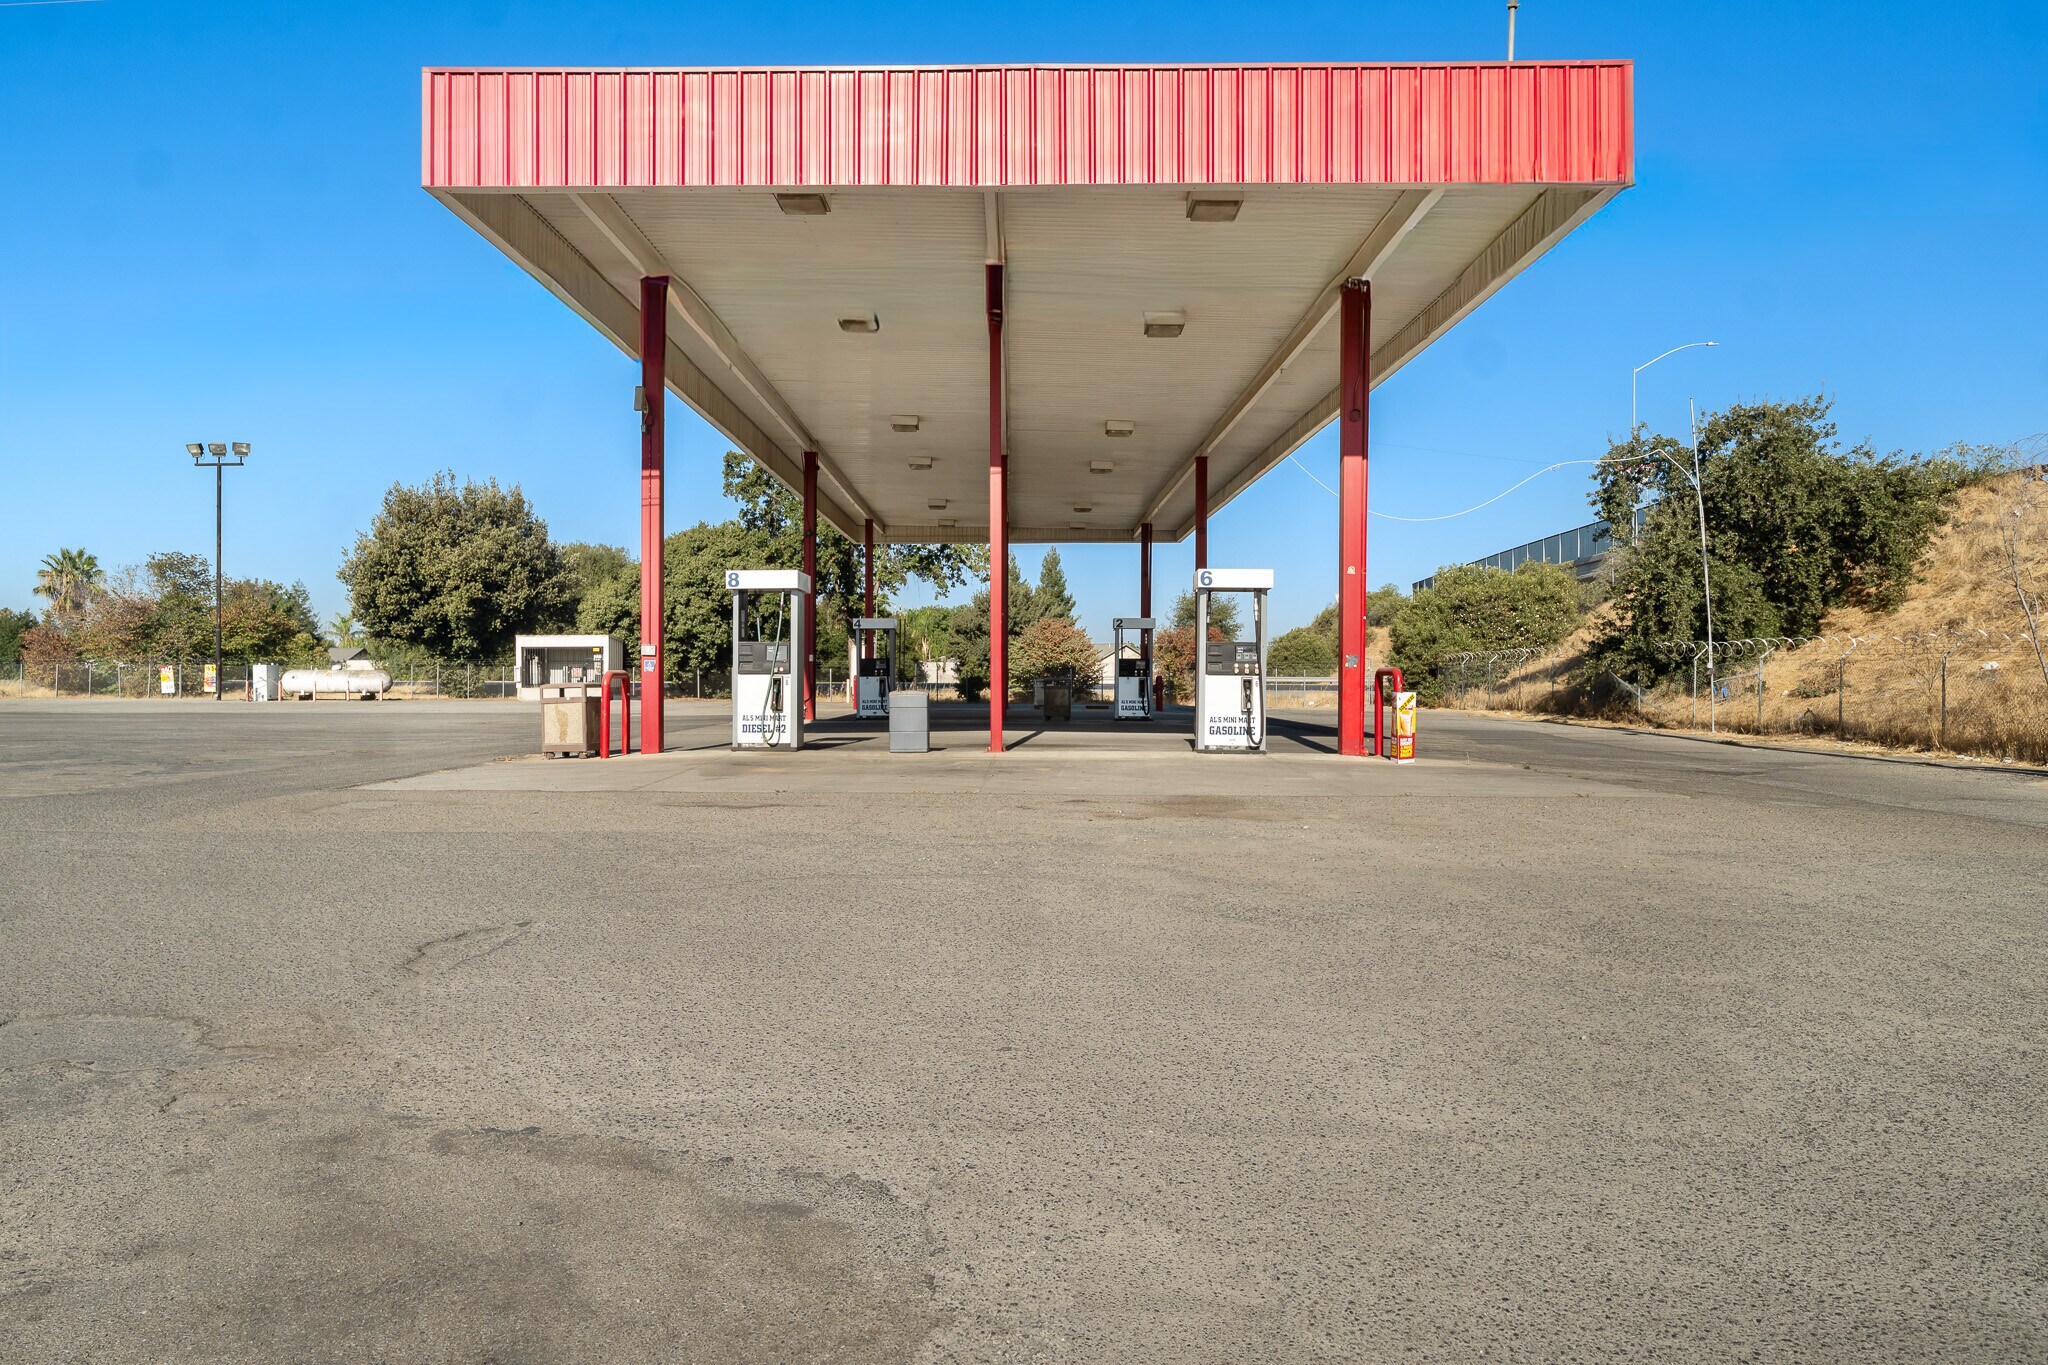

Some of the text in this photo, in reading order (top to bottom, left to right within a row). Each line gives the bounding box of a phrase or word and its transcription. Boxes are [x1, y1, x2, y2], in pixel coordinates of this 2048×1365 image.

[728, 573, 739, 587] 8
[1200, 571, 1212, 586] 6
[854, 620, 861, 629] 4
[1116, 619, 1123, 627] 2
[742, 724, 786, 733] DIESEL #2
[1209, 726, 1255, 735] GASOLINE
